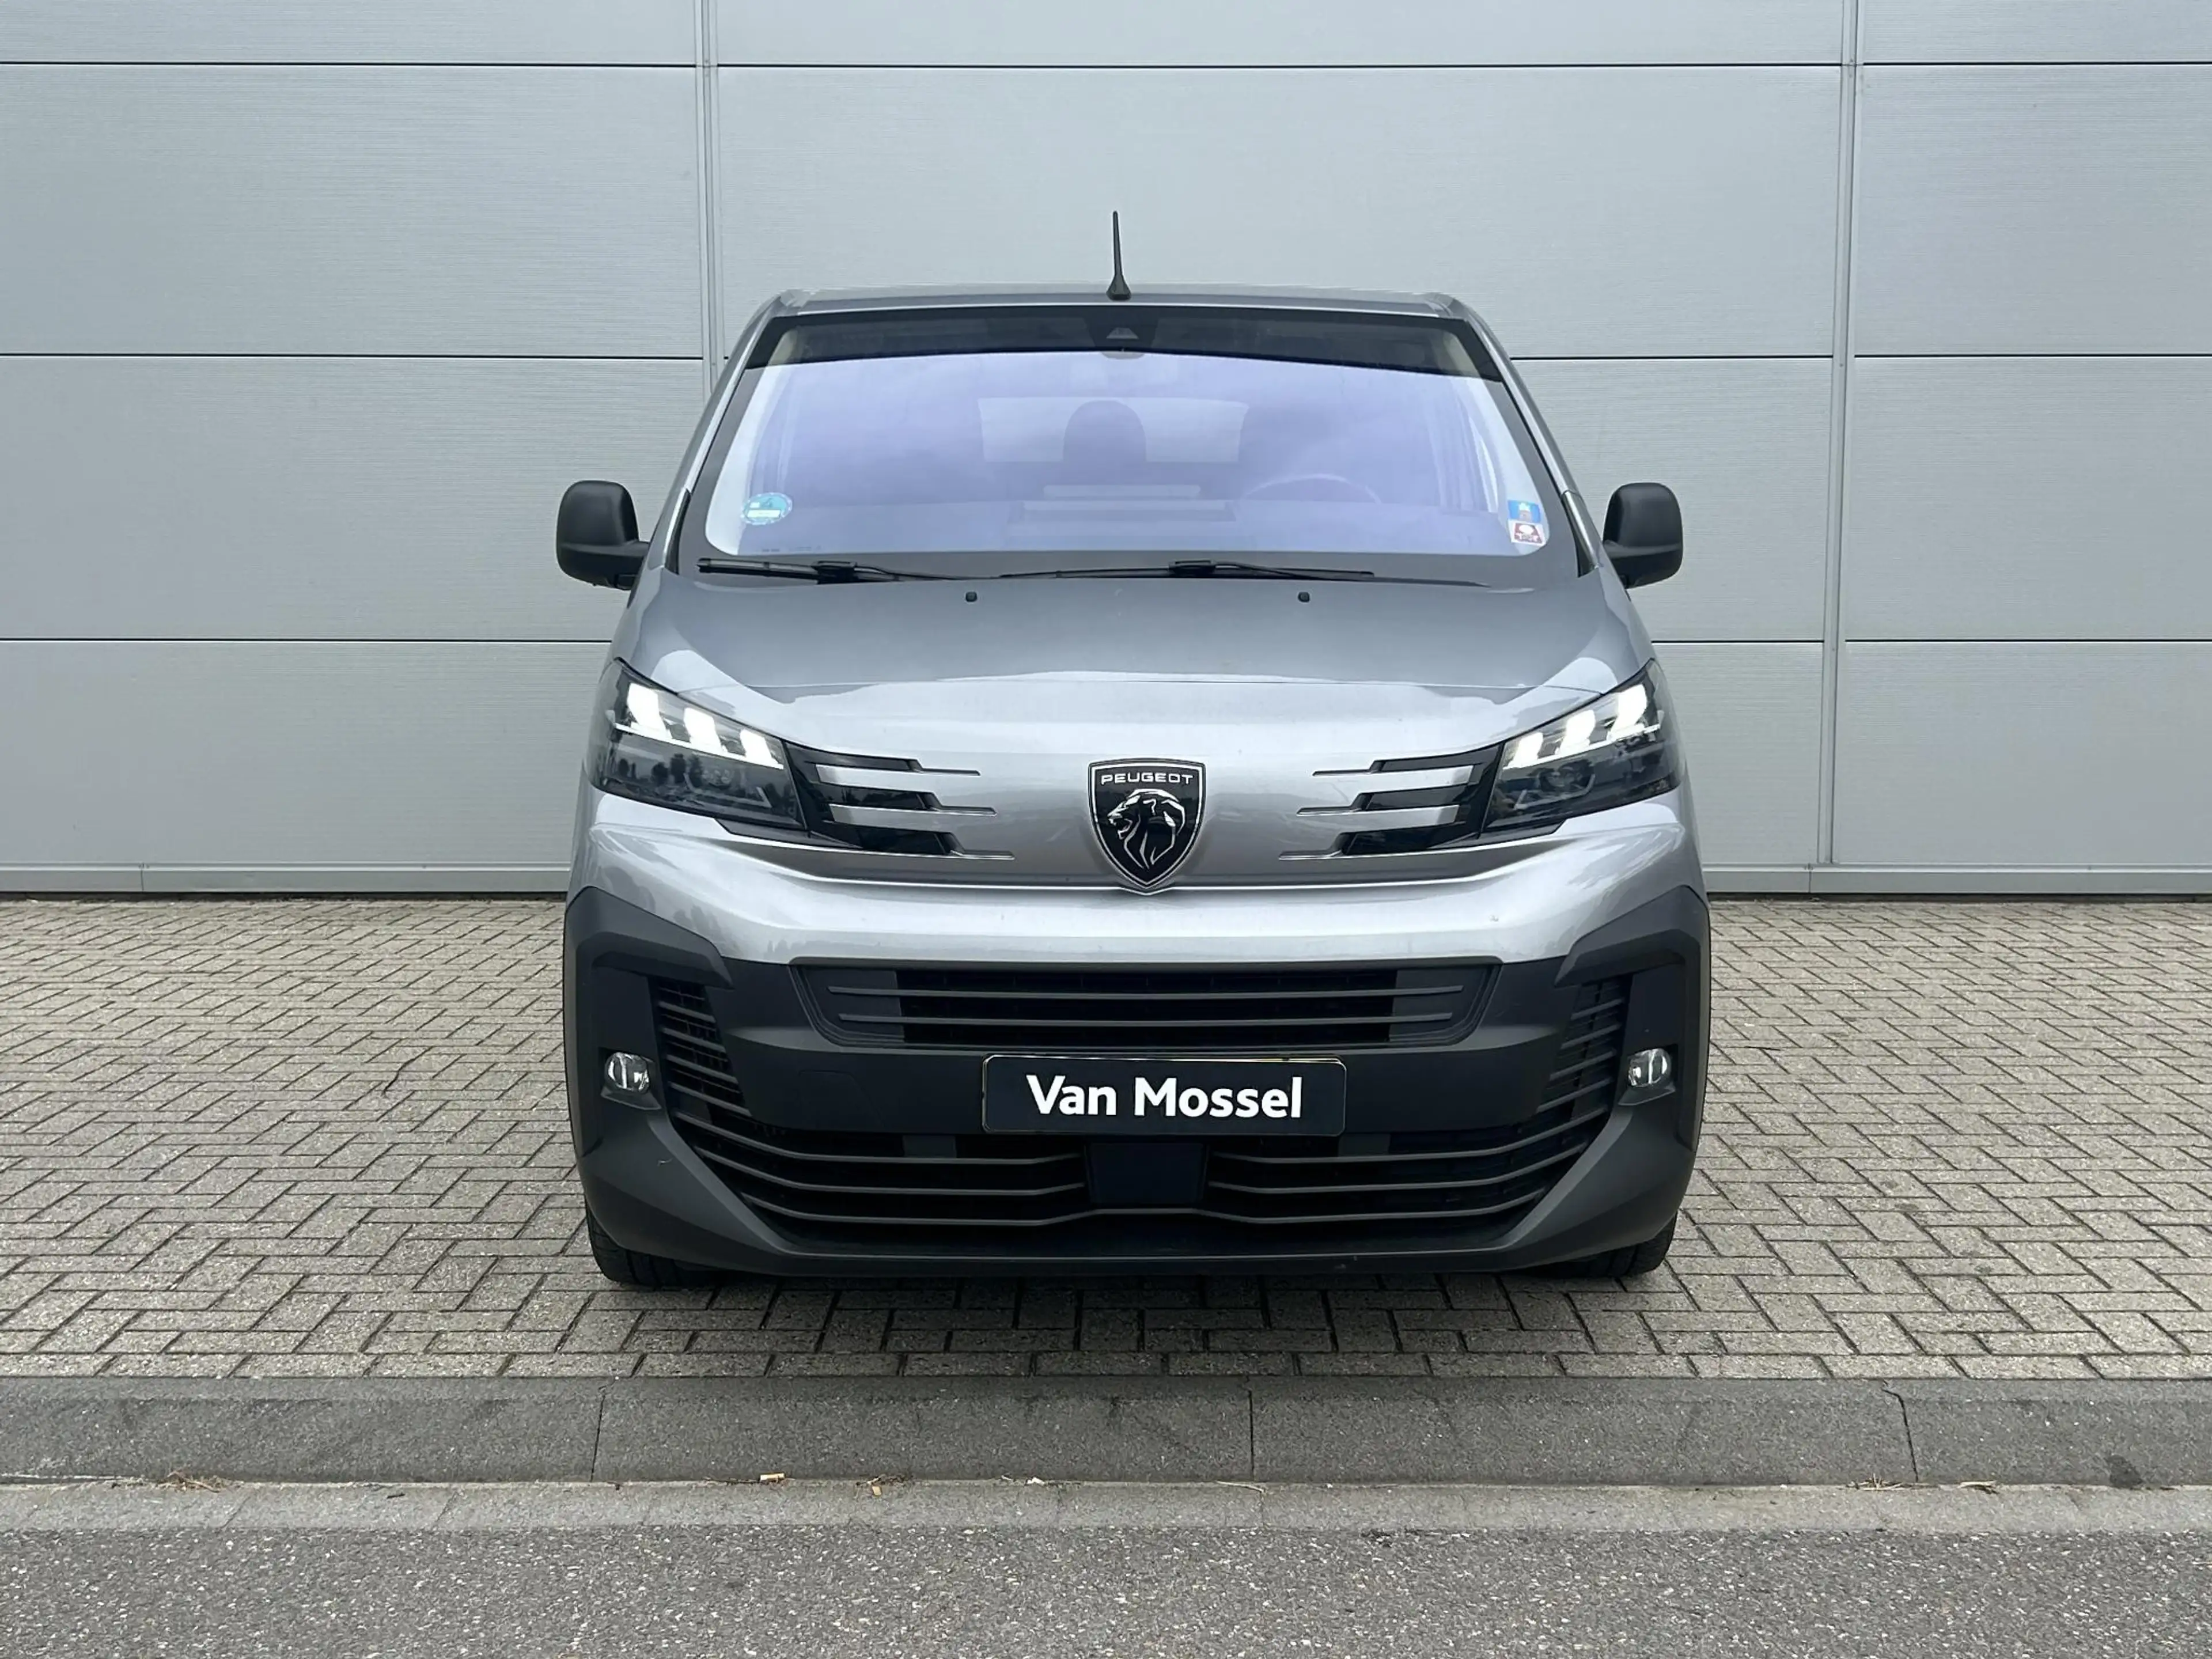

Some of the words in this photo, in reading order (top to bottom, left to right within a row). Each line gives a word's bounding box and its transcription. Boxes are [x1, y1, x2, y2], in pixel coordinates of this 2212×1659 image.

[1101, 772, 1194, 785] PEUGEOT
[1026, 1074, 1116, 1116] Van
[1134, 1077, 1302, 1118] Mossel
